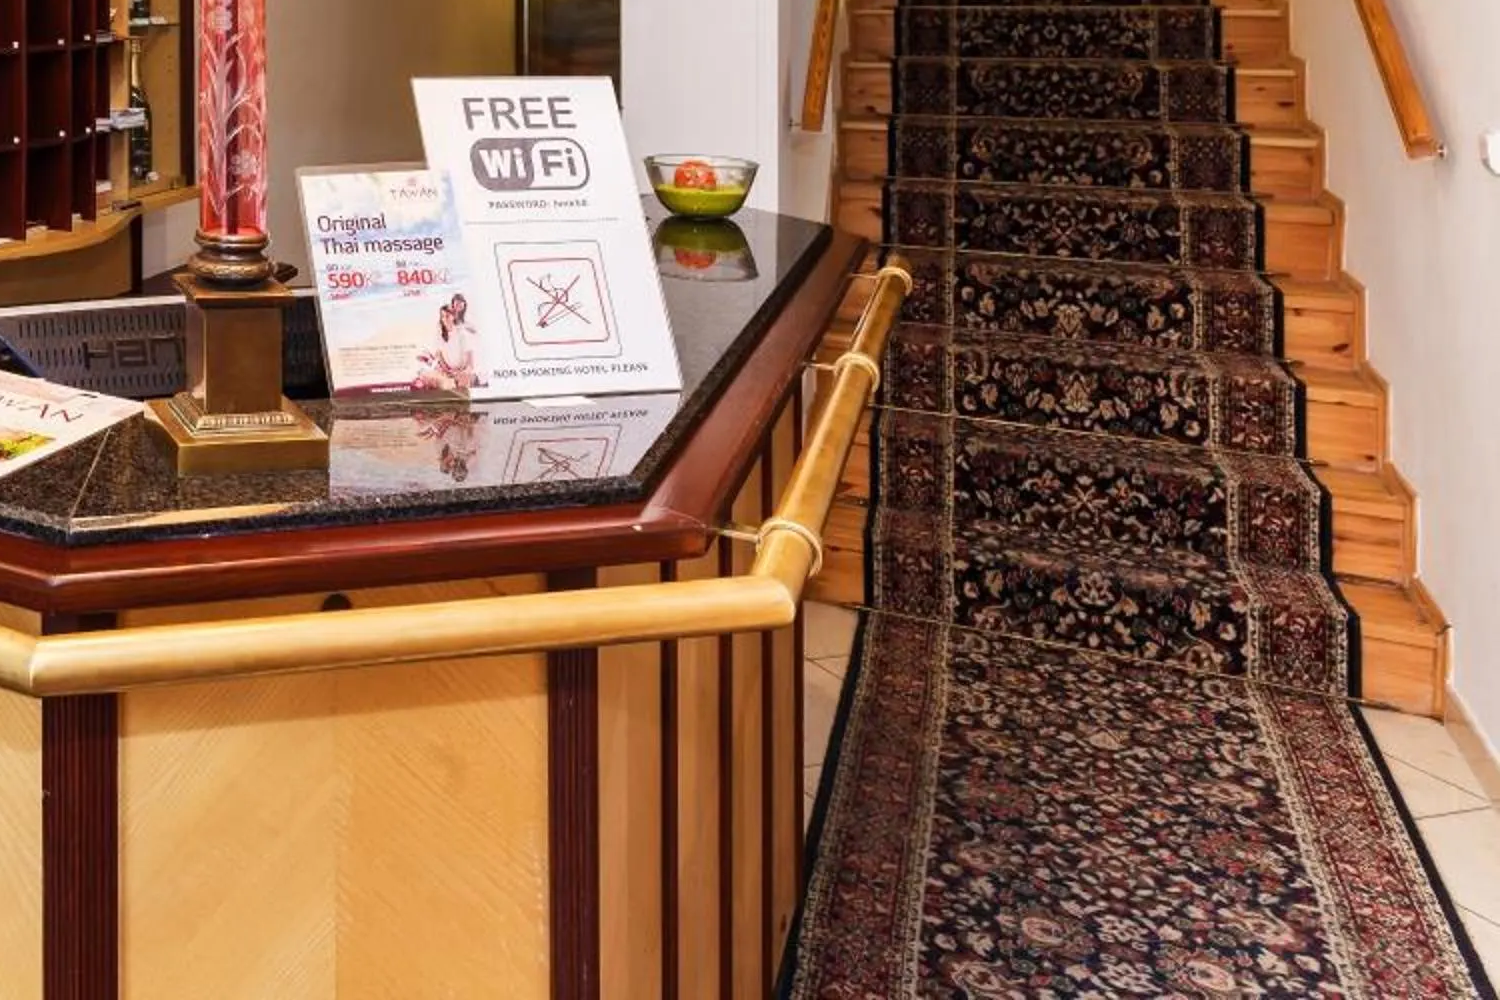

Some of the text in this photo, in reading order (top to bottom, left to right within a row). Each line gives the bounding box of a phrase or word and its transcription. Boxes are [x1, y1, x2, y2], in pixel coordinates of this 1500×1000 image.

[462, 96, 577, 130] FREE
[317, 212, 387, 236] Original
[320, 237, 445, 255] Thai massage
